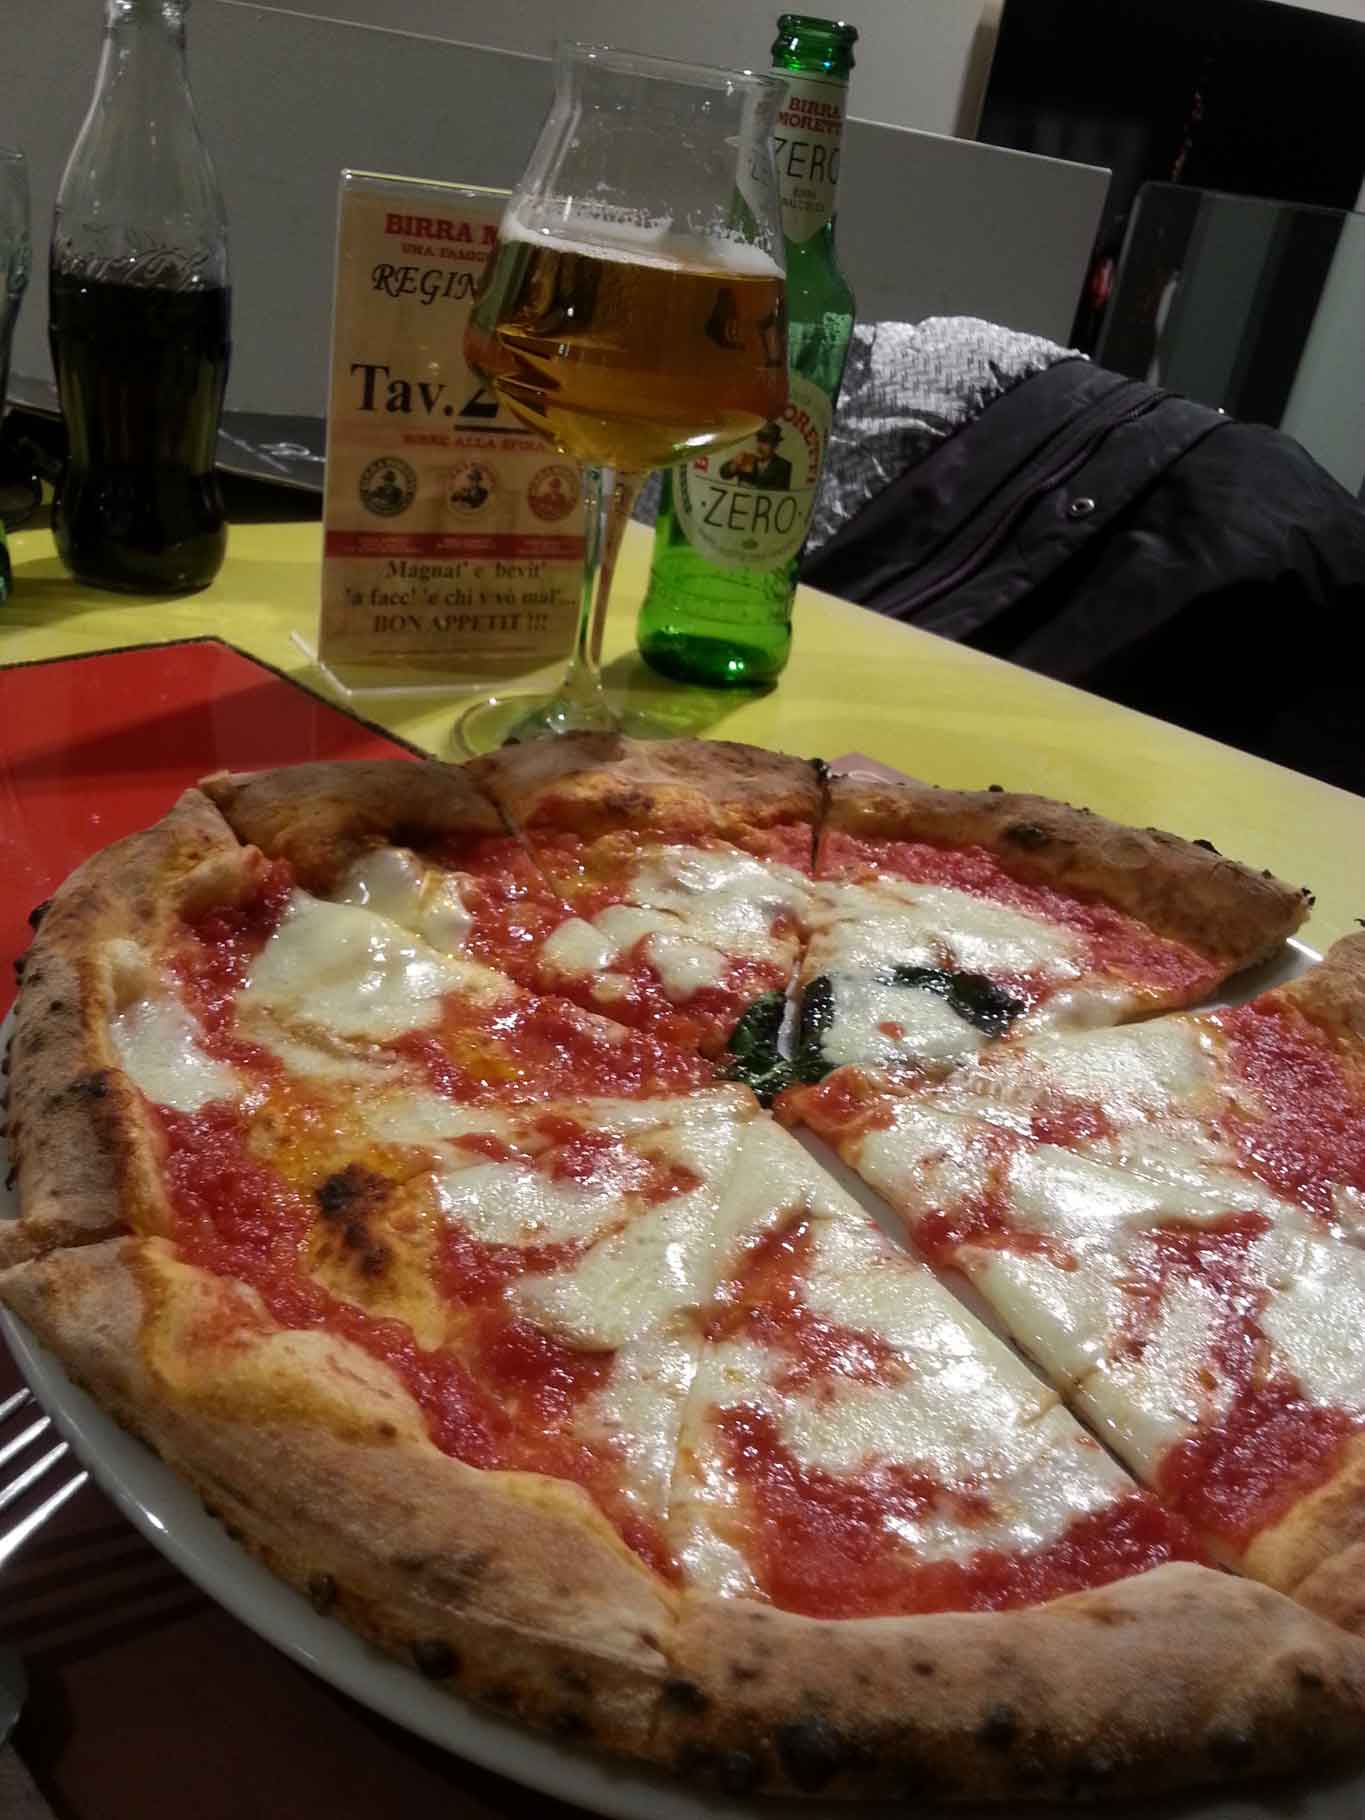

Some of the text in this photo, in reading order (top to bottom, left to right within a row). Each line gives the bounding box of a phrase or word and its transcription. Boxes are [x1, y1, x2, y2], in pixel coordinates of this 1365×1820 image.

[776, 111, 843, 136] MORETT
[384, 212, 473, 243] BIRRA
[371, 262, 480, 305] REGIN
[783, 402, 820, 485] ORETTI
[703, 486, 798, 535] ZERO
[373, 613, 423, 634] BON
